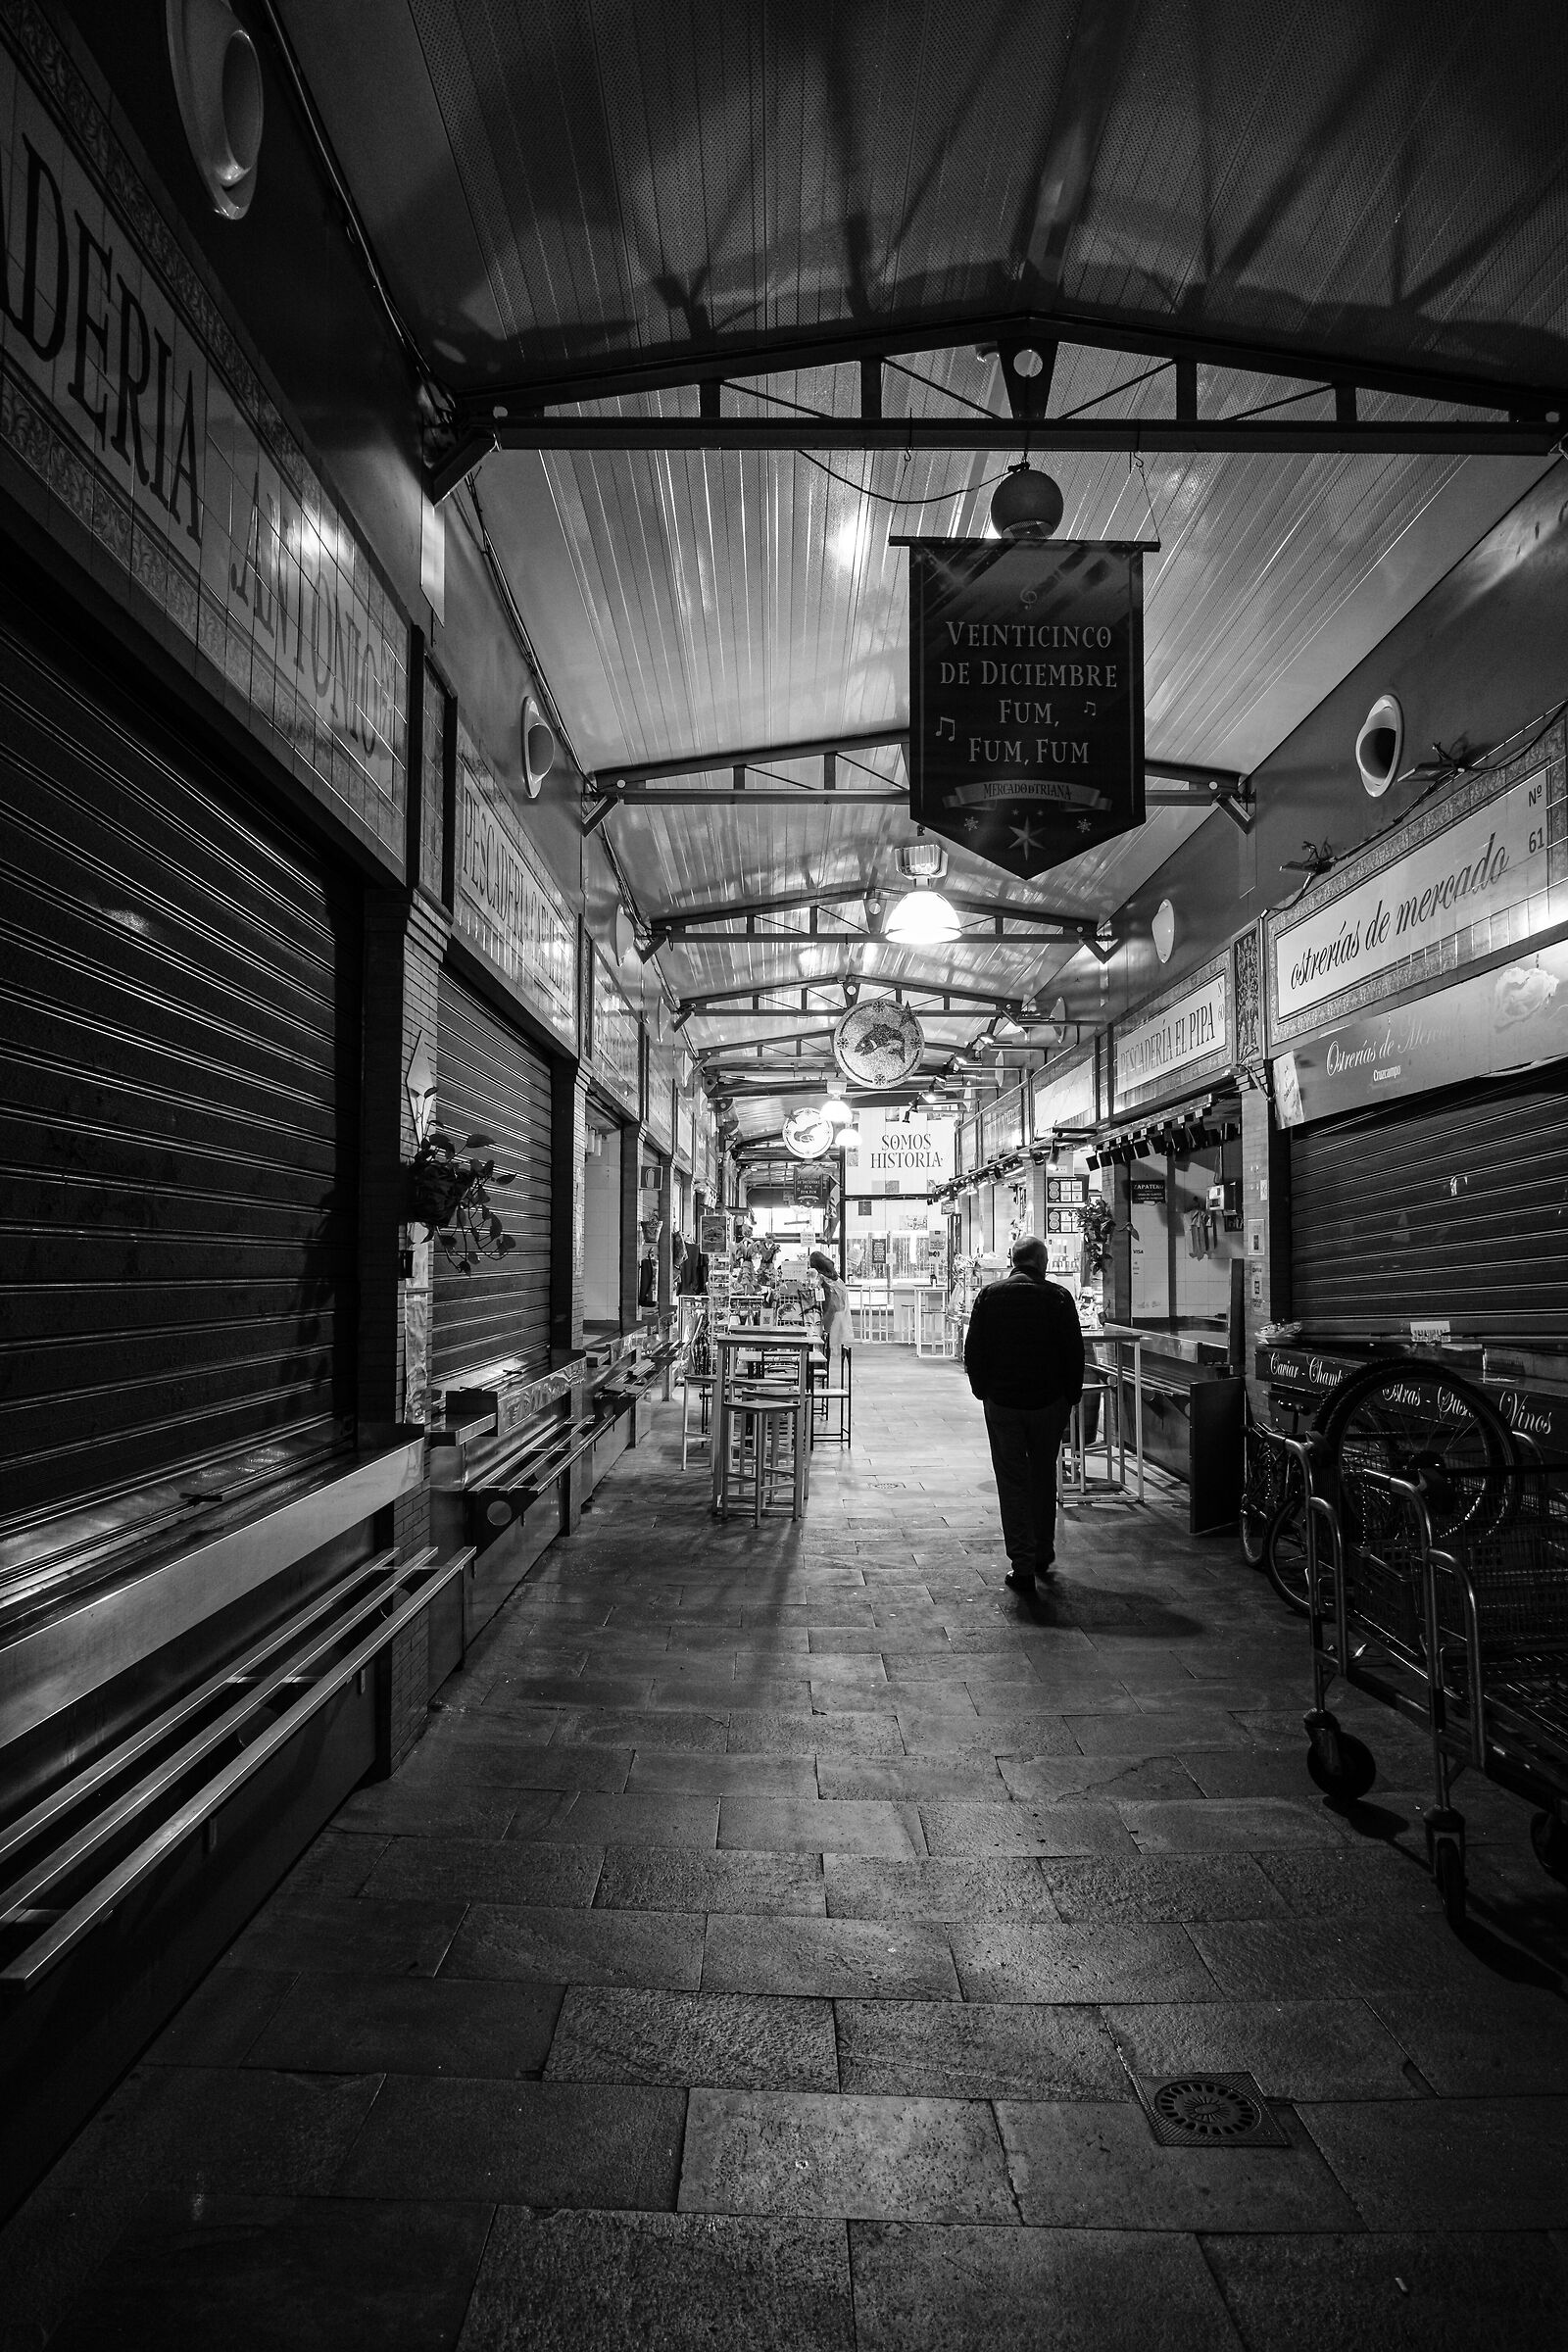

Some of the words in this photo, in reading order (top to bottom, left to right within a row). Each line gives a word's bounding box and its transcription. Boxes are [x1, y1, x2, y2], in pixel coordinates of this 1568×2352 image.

[946, 620, 1113, 650] VEINTICINCO
[940, 661, 970, 686] DE
[980, 660, 1118, 688] DICIEMBRE
[998, 699, 1059, 728] FUM,
[968, 736, 1029, 765] FUM,
[1035, 737, 1091, 765] FUM
[1528, 826, 1545, 855] 61
[1290, 920, 1361, 991] ostrerías
[1365, 900, 1392, 952] de
[1396, 831, 1510, 937] mercado
[1176, 1016, 1188, 1057] EL
[1189, 1001, 1216, 1051] PIPA
[1378, 1029, 1395, 1058] de
[881, 1133, 932, 1152] SOMOS
[870, 1152, 942, 1168] HISTORIA
[1269, 1351, 1299, 1379] Caviar
[1498, 1390, 1553, 1435] Vinos
